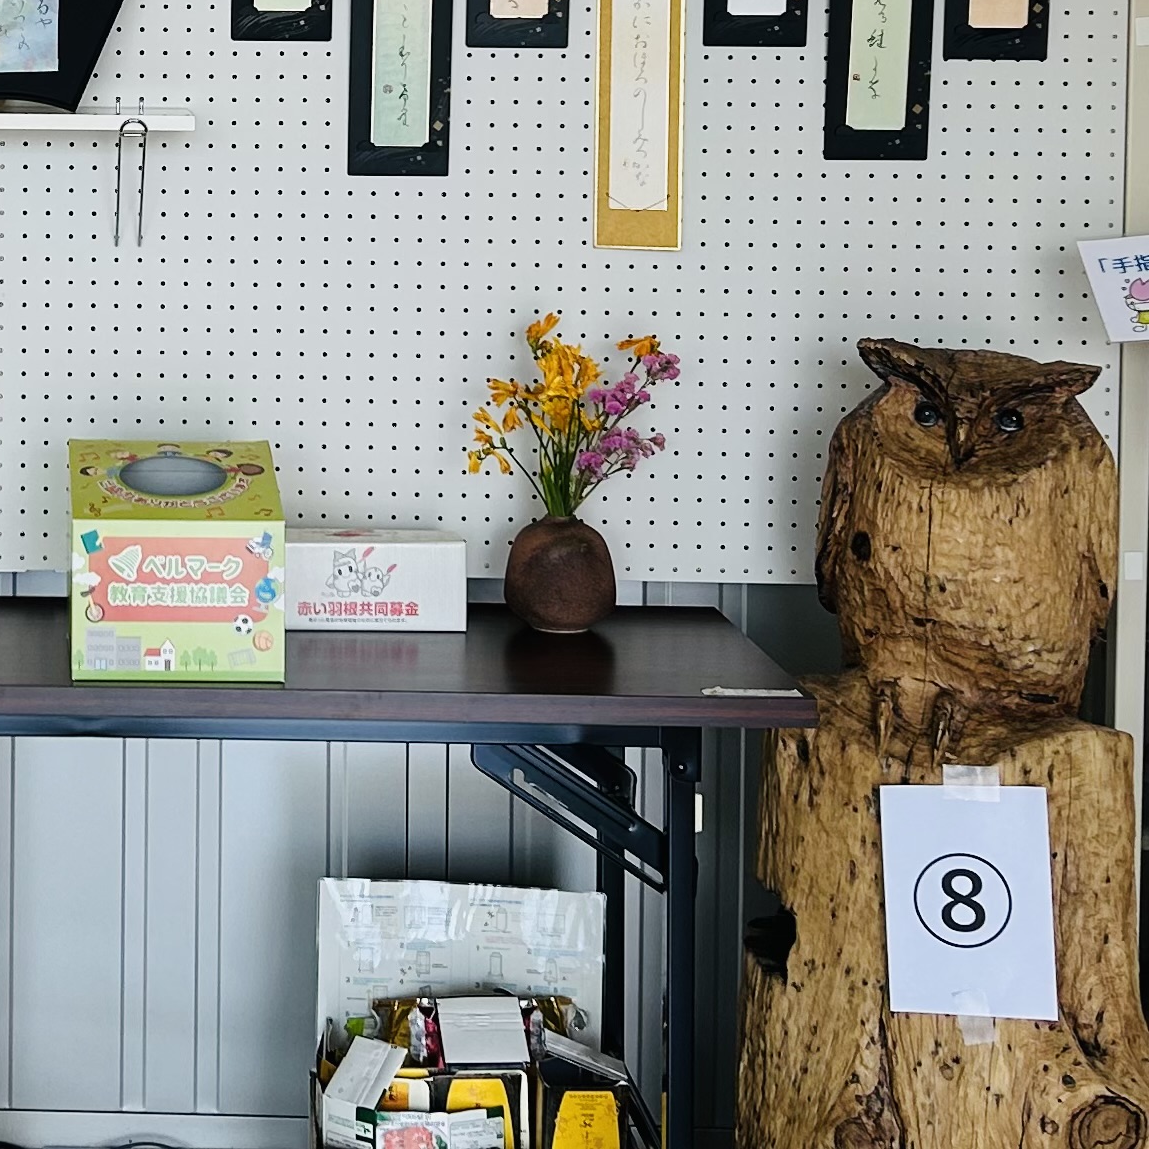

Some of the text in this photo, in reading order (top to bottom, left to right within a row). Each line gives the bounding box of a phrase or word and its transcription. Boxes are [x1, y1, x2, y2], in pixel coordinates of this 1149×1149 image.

[143, 556, 242, 580] ベルマーク
[108, 582, 249, 606] 教育支援協議会
[297, 601, 420, 617] 赤い羽根共同募金
